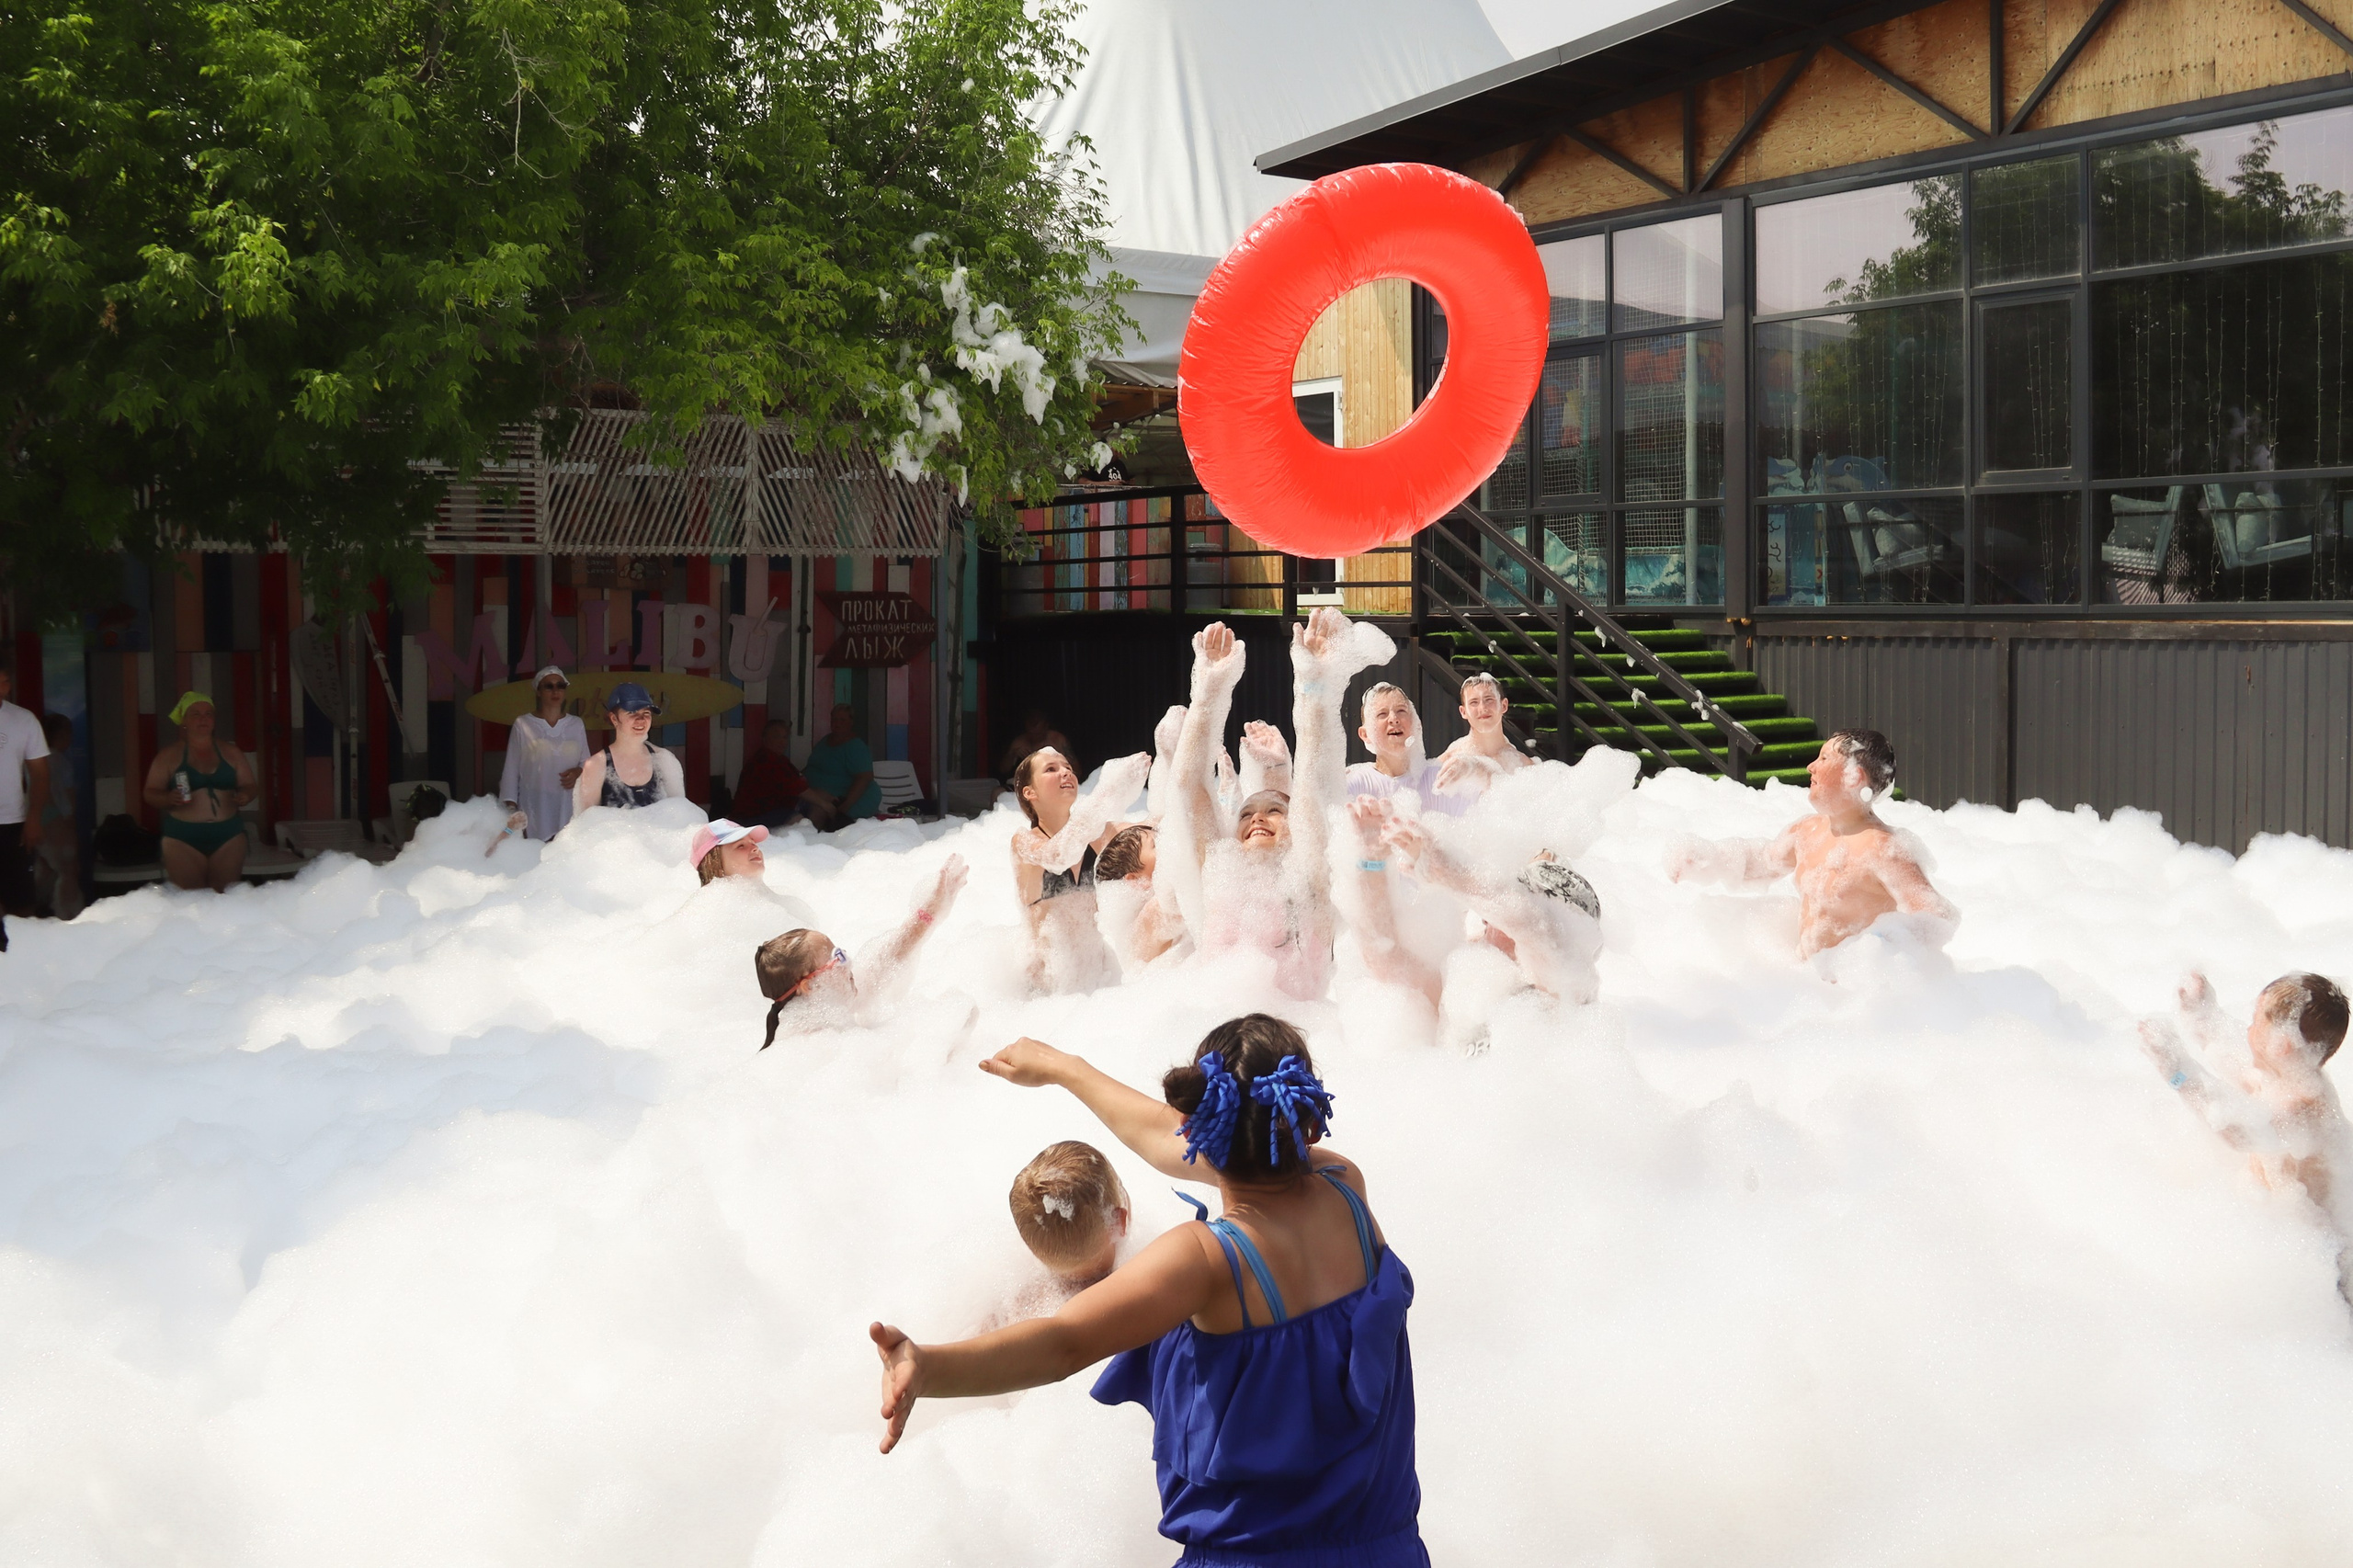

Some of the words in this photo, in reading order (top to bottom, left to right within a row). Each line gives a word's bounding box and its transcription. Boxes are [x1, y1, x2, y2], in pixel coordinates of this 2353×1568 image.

[842, 600, 913, 621] ПРОКАТ
[847, 622, 935, 634] МЕТАФИЗИЧЕСКИХ
[415, 598, 787, 701] MALIBU
[845, 636, 905, 660] ЛЫЖ
